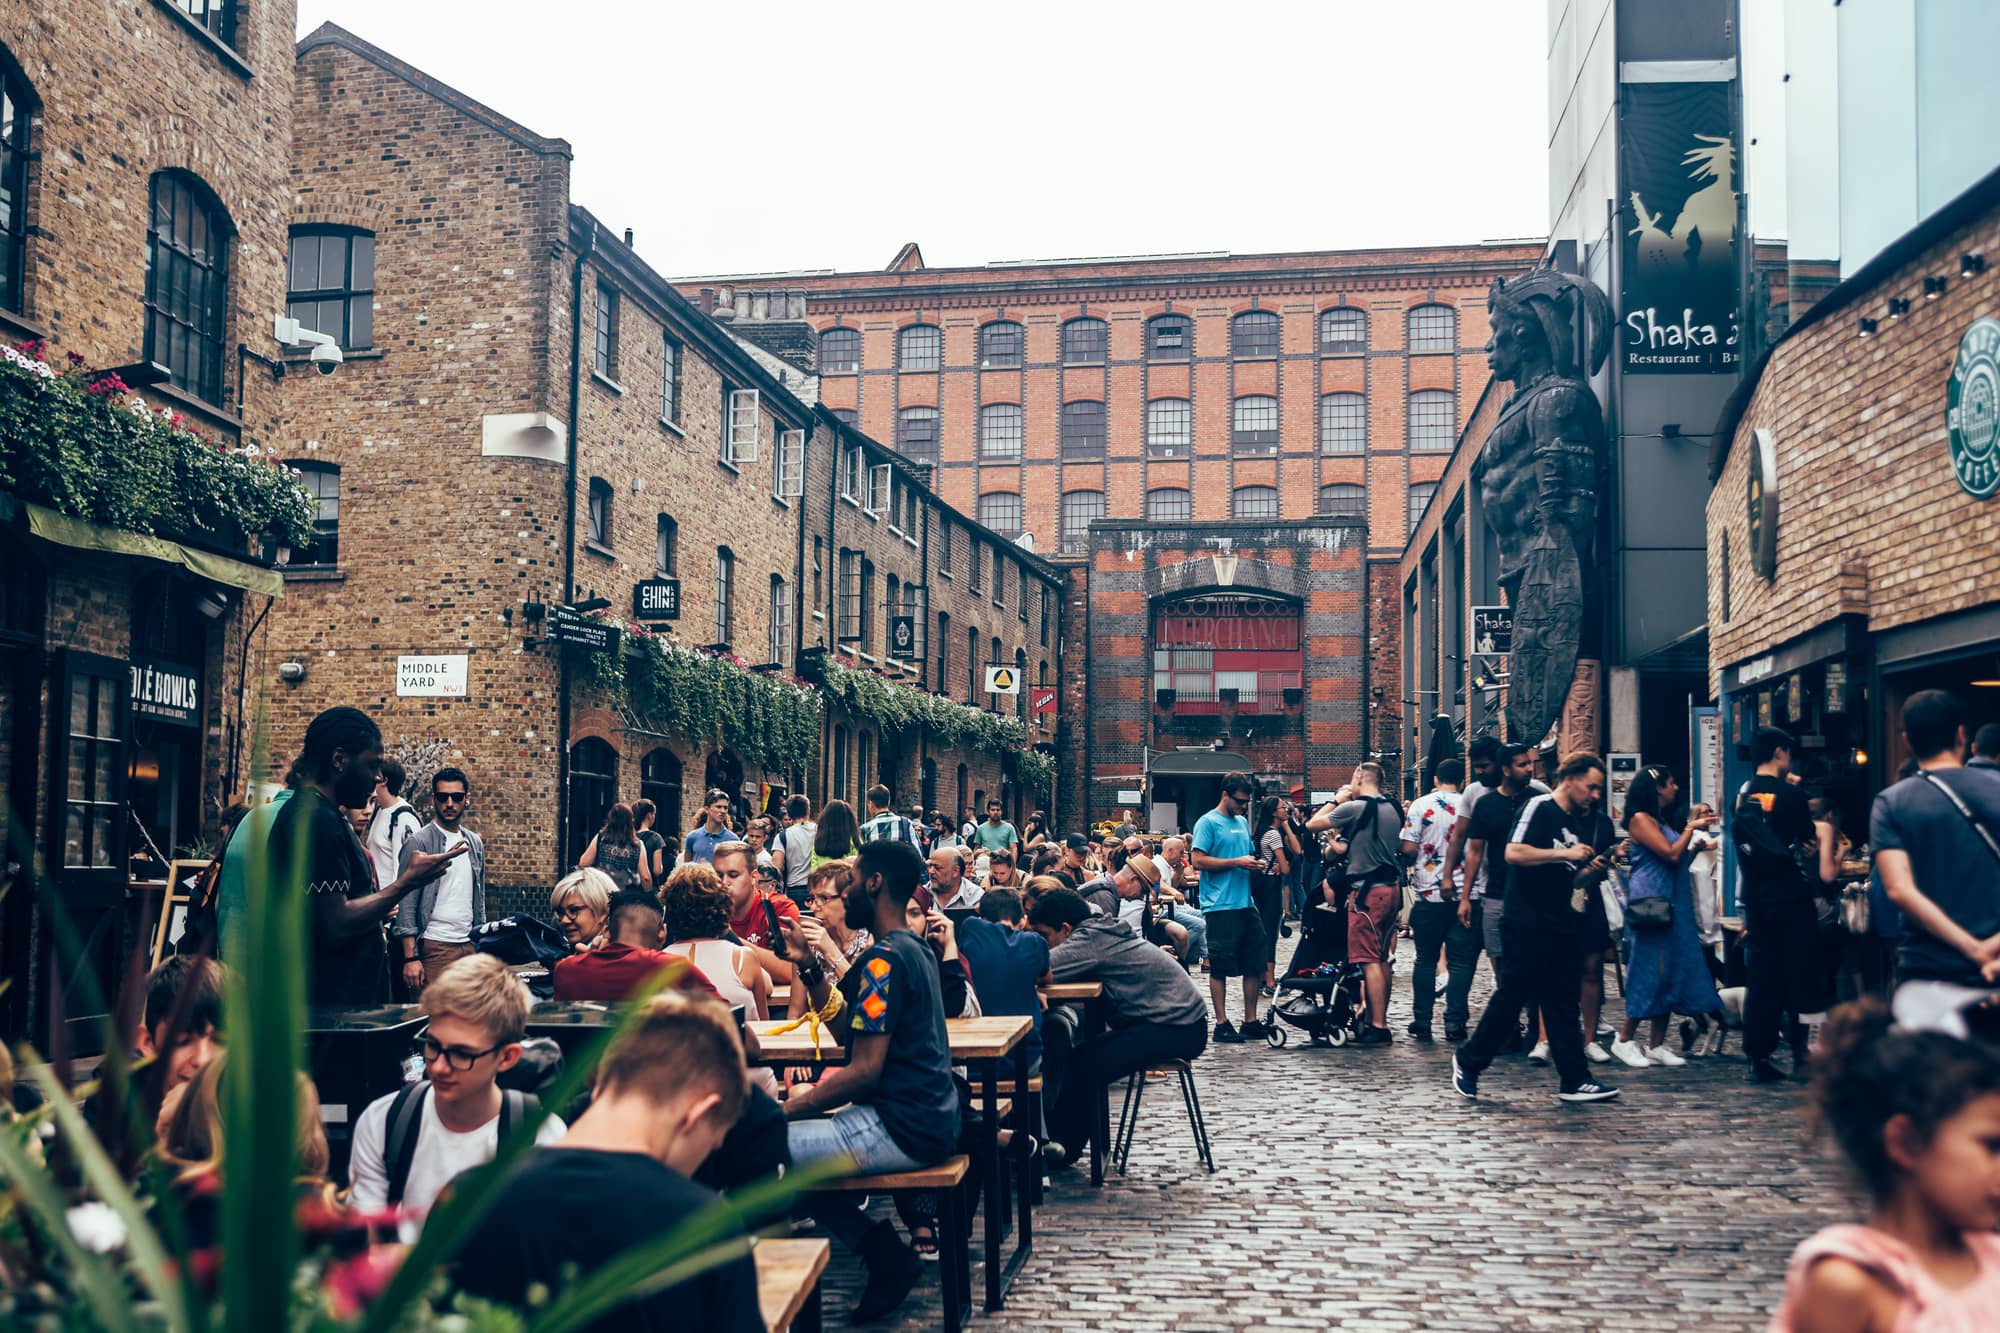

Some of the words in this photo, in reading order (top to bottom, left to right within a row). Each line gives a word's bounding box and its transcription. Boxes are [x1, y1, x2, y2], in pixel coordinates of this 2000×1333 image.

[1626, 307, 1718, 351] Shaka
[1629, 353, 1701, 364] Restaurant
[1956, 448, 2000, 487] COFFE
[1214, 596, 1240, 617] THE
[560, 623, 580, 631] CAMDEN
[580, 626, 592, 634] LOCK
[592, 628, 607, 636] PLACE
[1475, 613, 1512, 630] Shaka
[402, 663, 448, 674] MIDDLE
[155, 671, 196, 710] BOWLS
[401, 676, 435, 688] YARD
